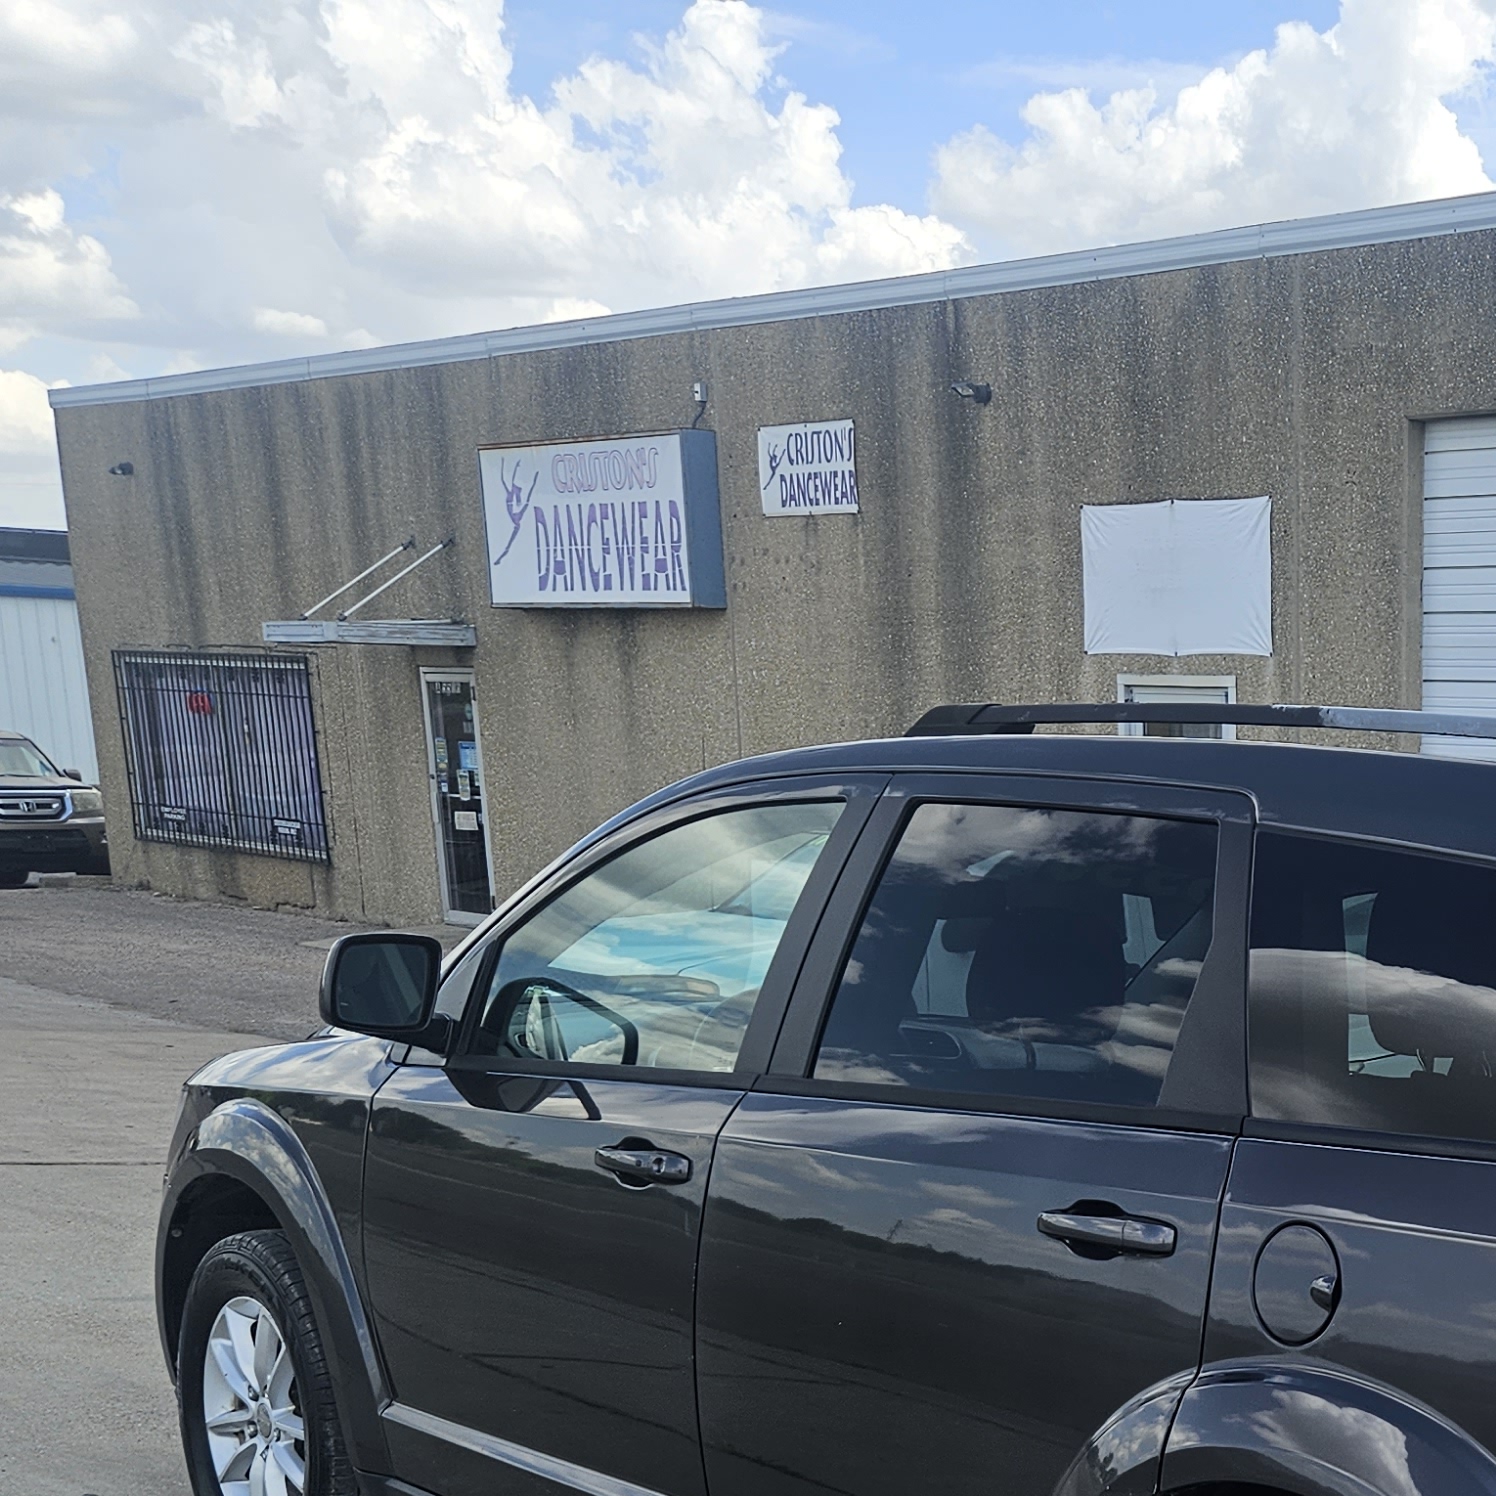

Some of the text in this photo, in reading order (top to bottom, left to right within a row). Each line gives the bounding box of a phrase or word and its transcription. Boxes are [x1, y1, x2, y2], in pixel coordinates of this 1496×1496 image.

[785, 428, 853, 466] CRISTON'S
[551, 447, 659, 494] CRISTON'S
[779, 469, 857, 508] DANCEWEAR
[534, 500, 688, 592] DANCEWEAR
